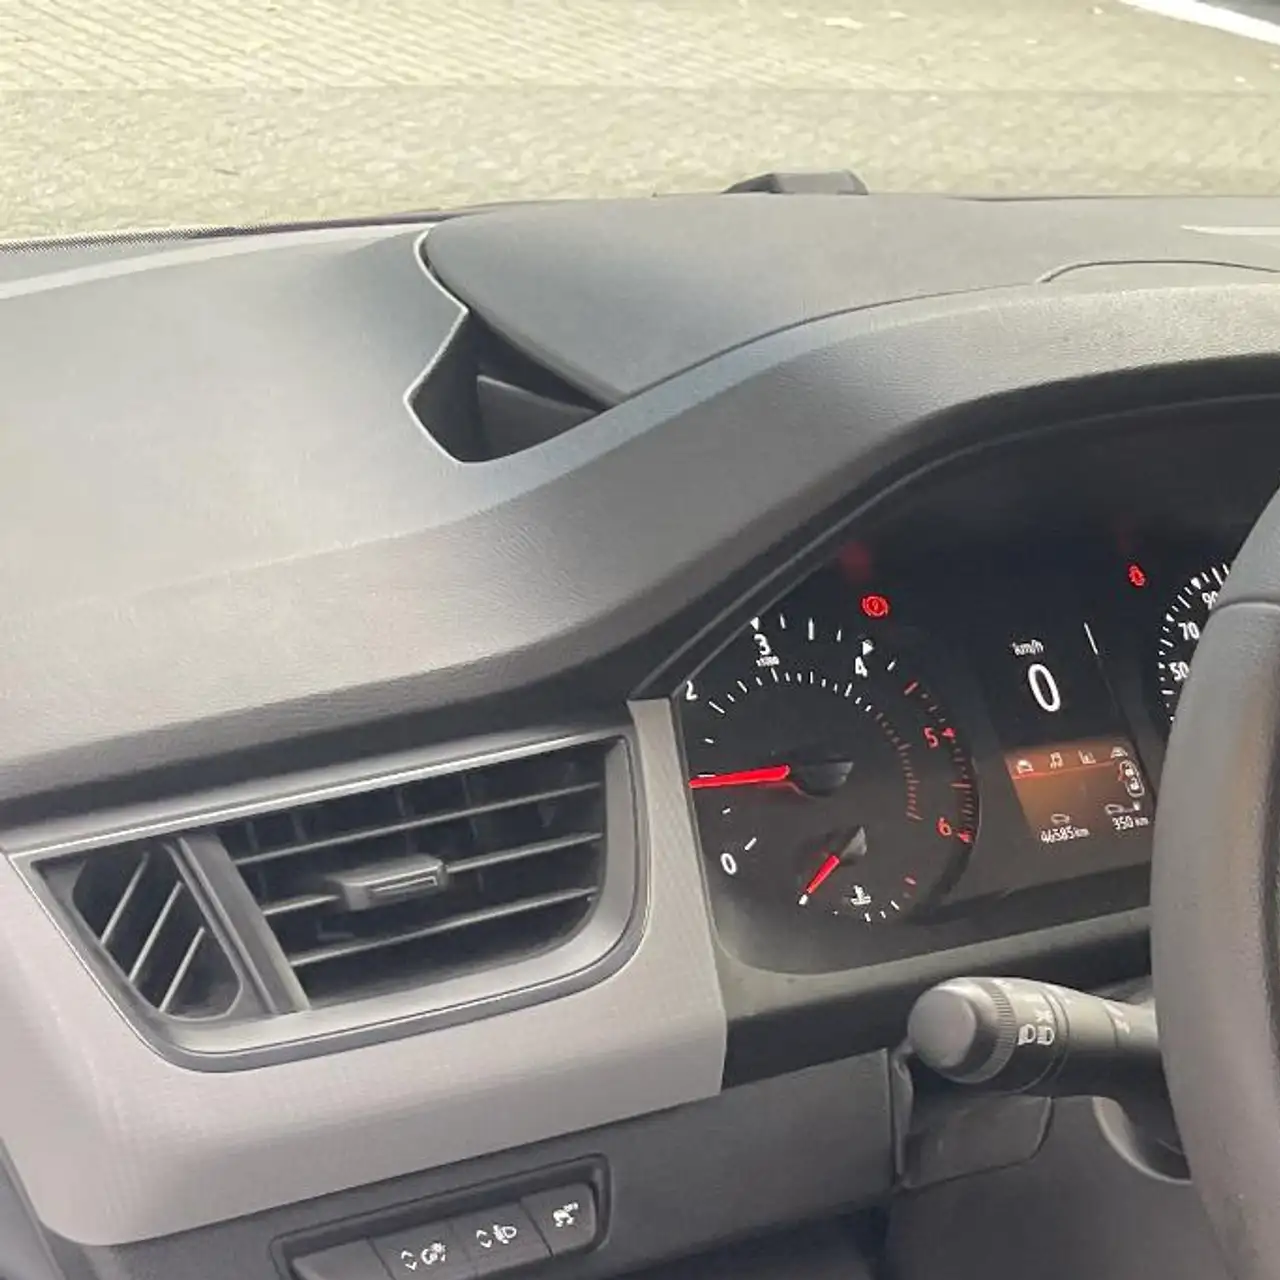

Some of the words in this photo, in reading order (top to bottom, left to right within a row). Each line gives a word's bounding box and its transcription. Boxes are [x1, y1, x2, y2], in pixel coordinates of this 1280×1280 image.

[1178, 621, 1201, 641] 70
[753, 633, 771, 656] 3
[855, 656, 868, 678] 4
[1168, 660, 1190, 682] 50
[686, 680, 699, 700] 2
[1028, 663, 1061, 712] 0
[924, 727, 939, 748] 5
[936, 817, 952, 837] 6
[720, 853, 737, 875] 0
